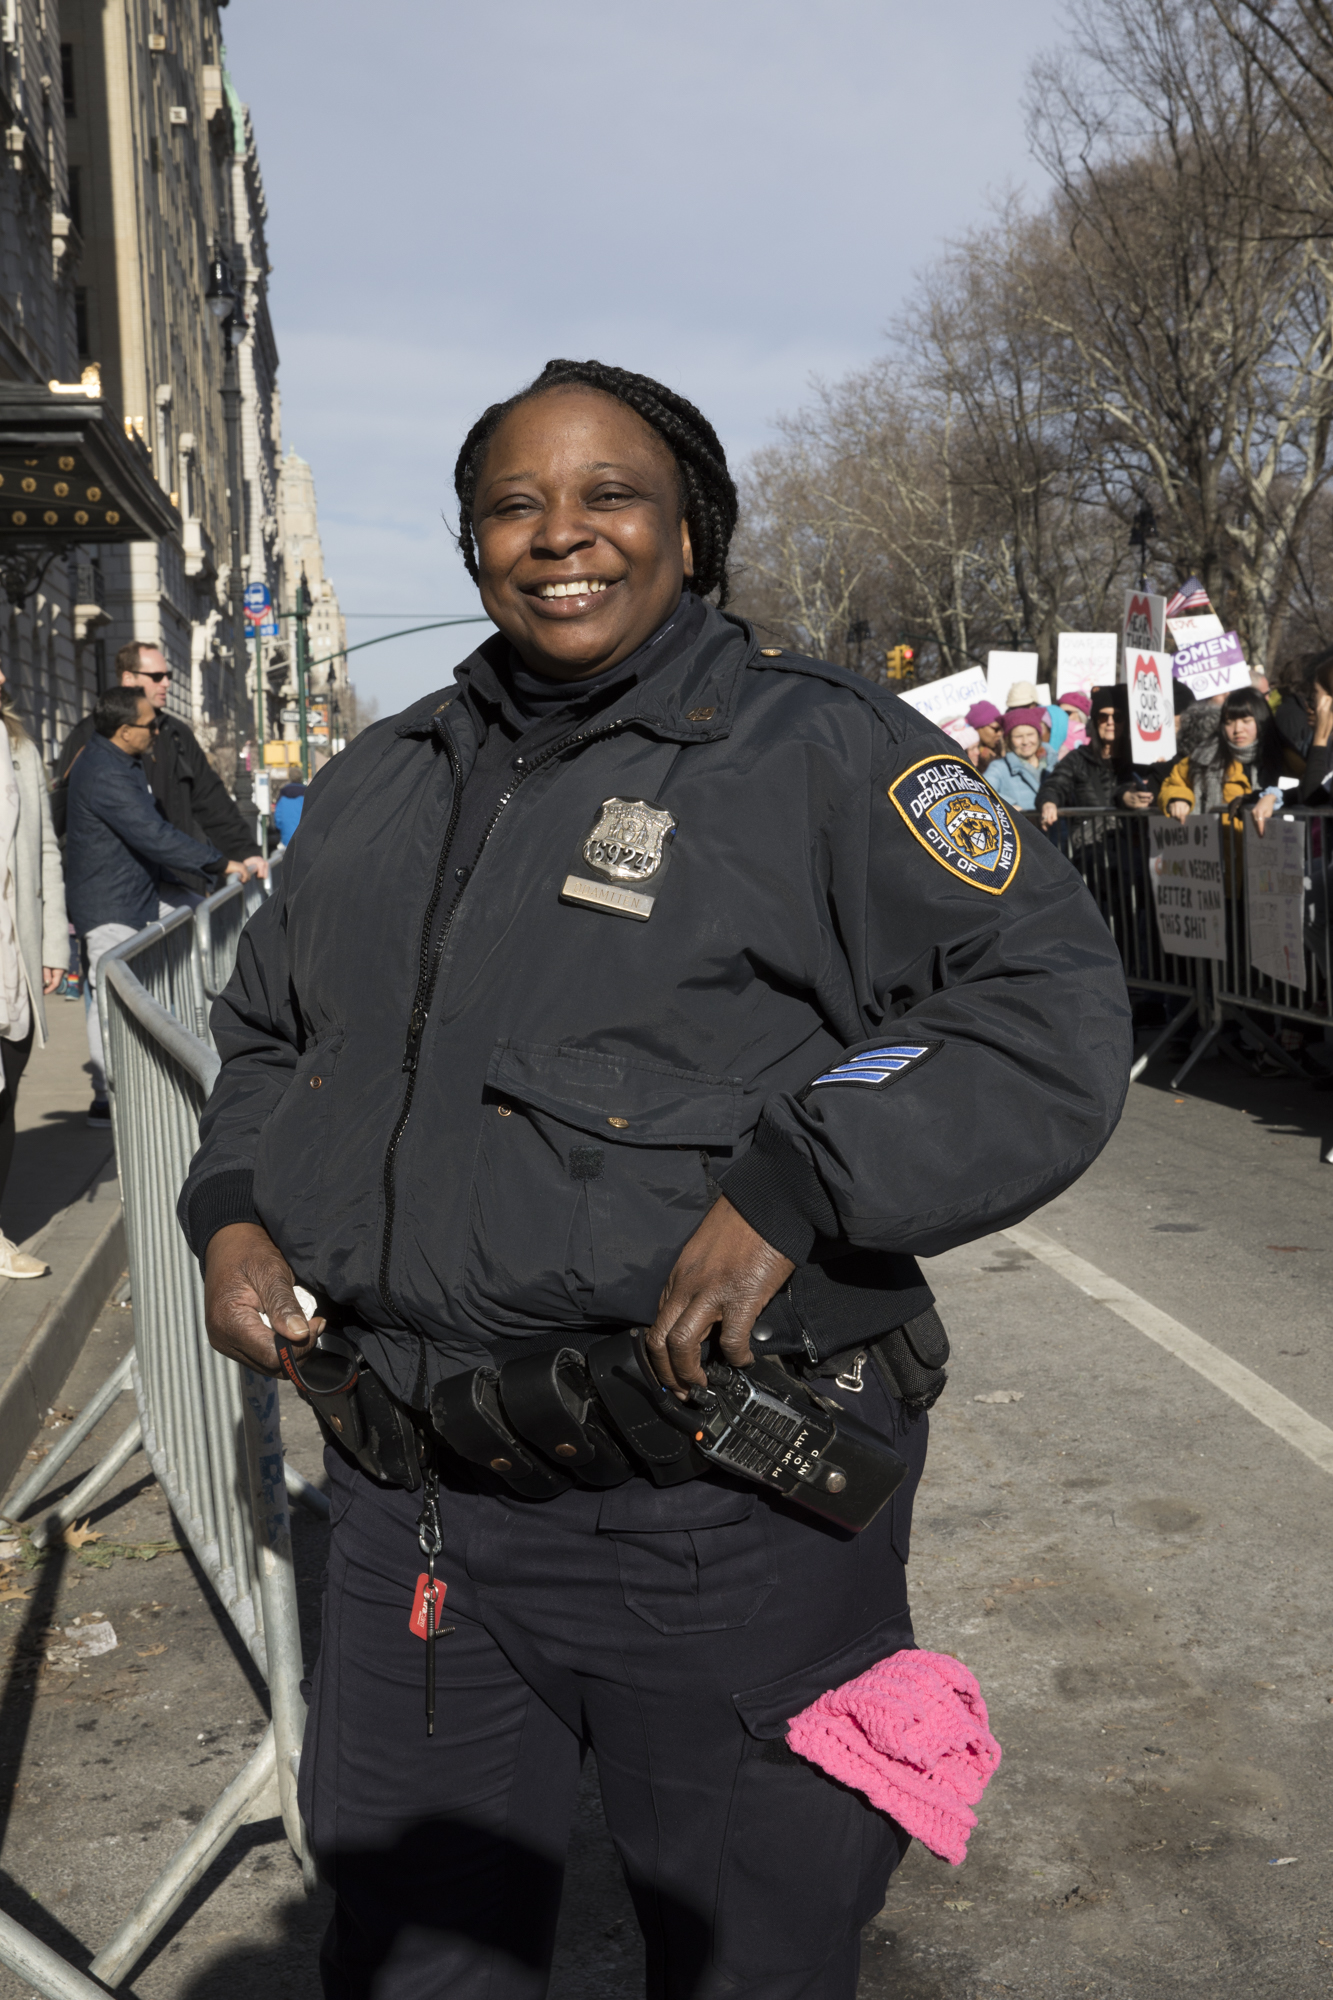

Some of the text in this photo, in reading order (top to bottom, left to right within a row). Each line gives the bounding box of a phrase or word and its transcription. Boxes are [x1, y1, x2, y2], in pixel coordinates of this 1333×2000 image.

[1129, 614, 1149, 635] HEAR
[1173, 634, 1237, 666] OMEN
[1178, 656, 1220, 677] UNITE
[942, 679, 988, 706] RIGHTS
[1137, 673, 1159, 692] HEAR
[1140, 693, 1158, 711] OUR
[1136, 710, 1161, 732] VOICE
[916, 764, 968, 789] POLICE
[910, 778, 991, 819] DEPARTMENT
[992, 803, 1014, 870] NEW YORK
[1153, 825, 1208, 850] WOMEN OF
[594, 840, 650, 874] 6924
[926, 828, 978, 873] CITY OF
[1188, 858, 1221, 884] DESERVE
[1157, 884, 1221, 911] BETTER THAN
[279, 1346, 289, 1361] NO
[793, 1454, 804, 1465] O
[797, 1449, 819, 1476] NYD
